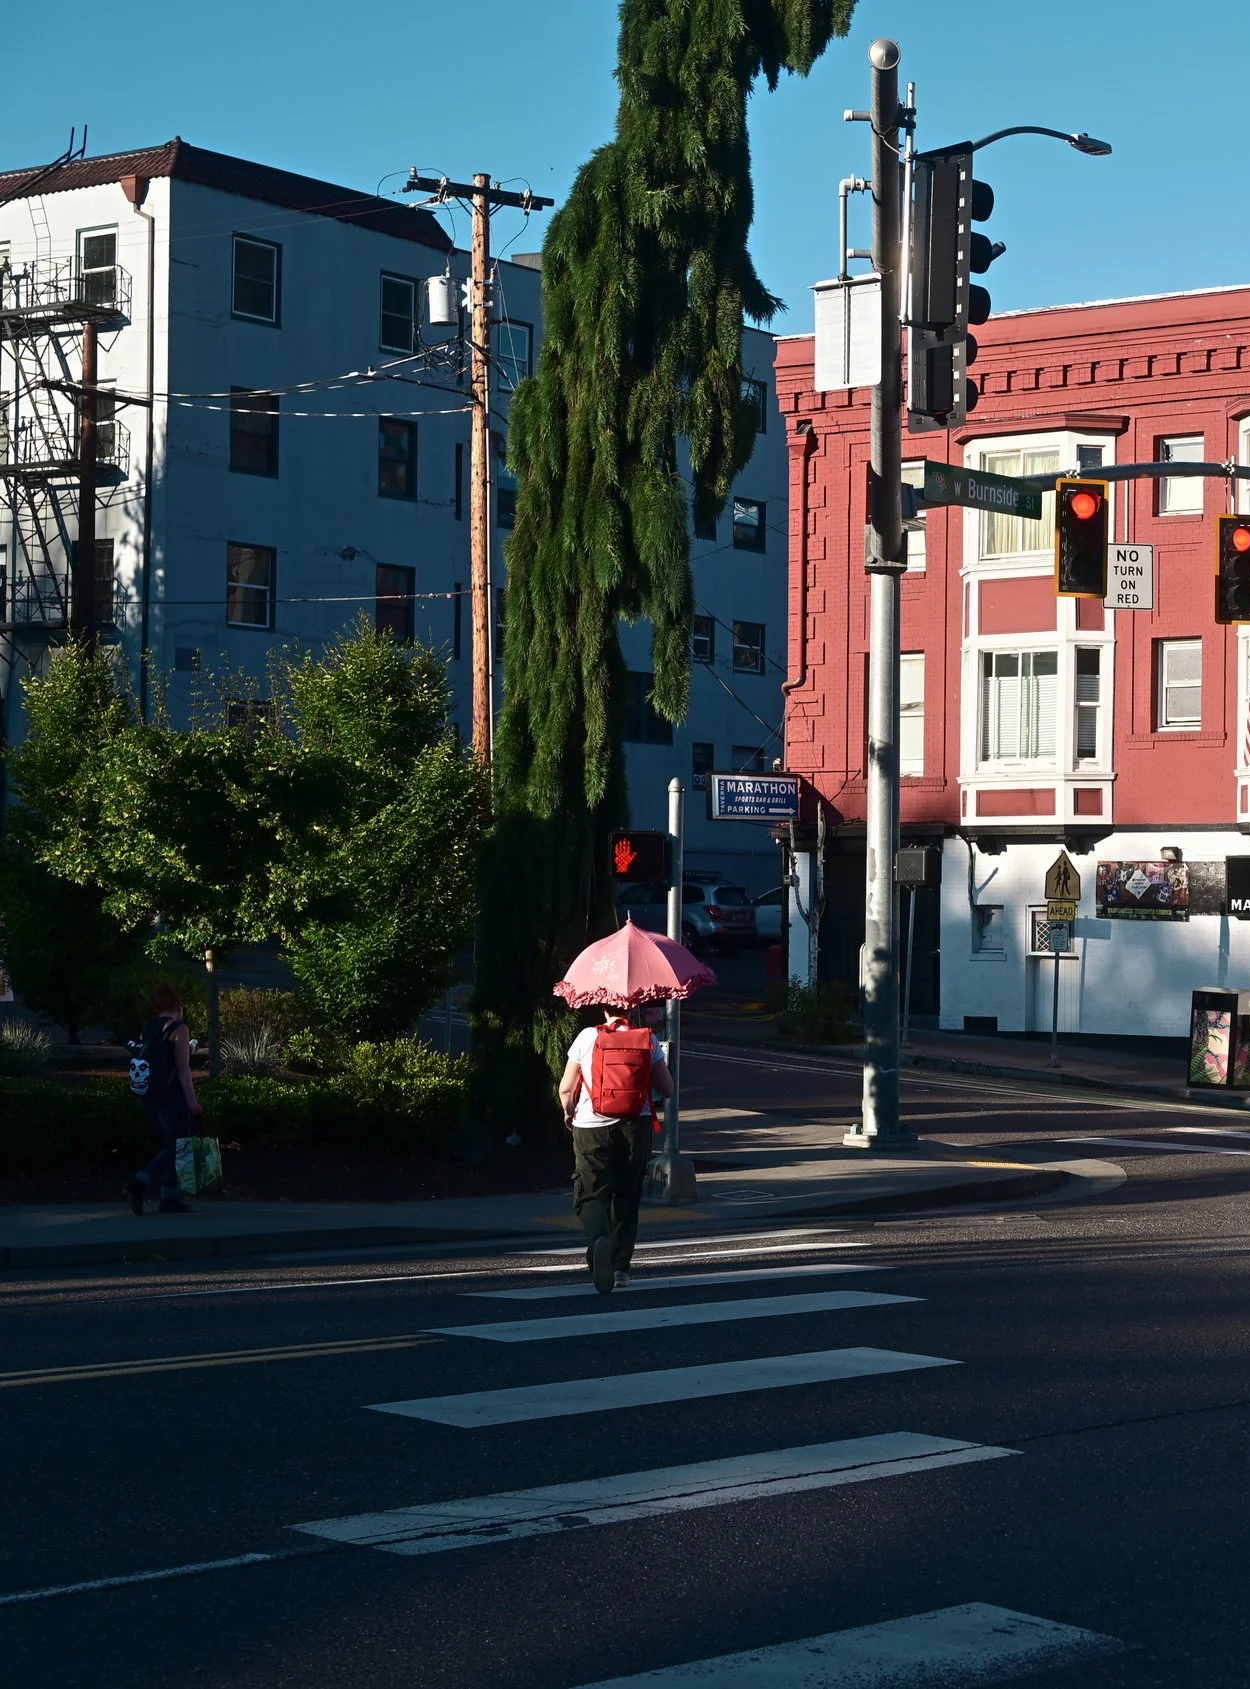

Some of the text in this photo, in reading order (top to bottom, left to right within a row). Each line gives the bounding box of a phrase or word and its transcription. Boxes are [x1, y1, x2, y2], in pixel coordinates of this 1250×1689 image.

[954, 481, 962, 497] W
[968, 478, 1019, 507] Burnside
[1116, 549, 1139, 562] NO
[1113, 565, 1143, 576] TURN
[1120, 579, 1136, 590] ON
[1117, 593, 1139, 604] RED
[726, 781, 796, 795] MARATHON
[734, 795, 755, 803] SPORTS
[755, 796, 766, 804] BAR
[727, 805, 766, 814] PARKING
[1050, 906, 1073, 916] AHEAD
